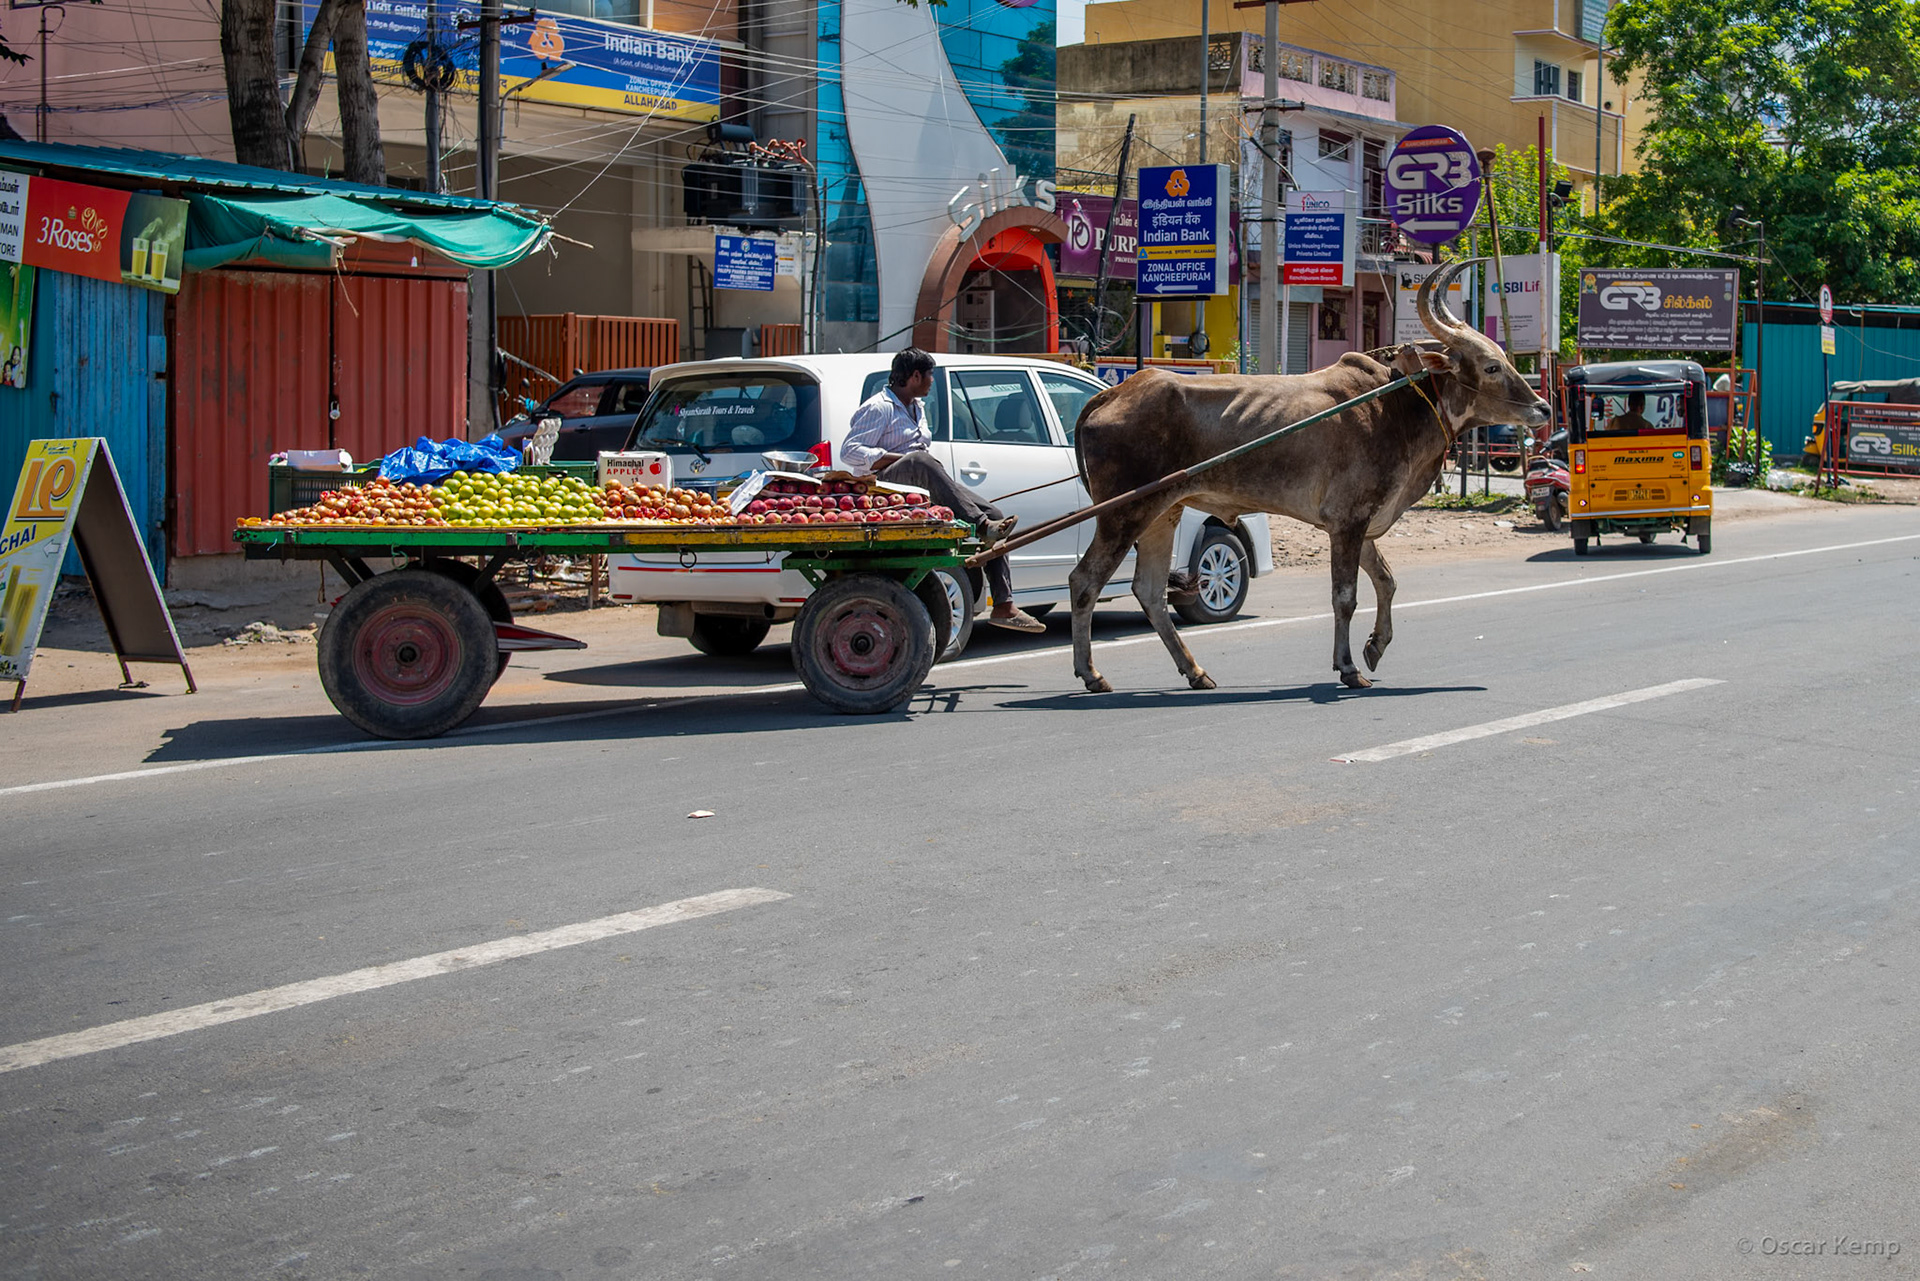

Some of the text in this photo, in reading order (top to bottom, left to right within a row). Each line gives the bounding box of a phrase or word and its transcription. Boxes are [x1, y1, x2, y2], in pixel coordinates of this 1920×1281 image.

[604, 31, 695, 65] Indian Bank
[634, 60, 640, 68] of
[640, 61, 654, 70] India
[625, 83, 676, 97] KANCHEEPURAM
[624, 94, 677, 110] ALLAHABAD
[1387, 151, 1472, 190] GRB
[1142, 197, 1212, 210] இந்தியன் வங்கி
[1306, 201, 1330, 209] UNICO
[1396, 193, 1463, 214] Silks
[1152, 212, 1183, 228] इंडियन
[1143, 228, 1210, 242] Indian Bank
[1147, 262, 1206, 272] ZONAL OFFICE
[1142, 271, 1211, 283] KANCHEEPURAM
[1504, 282, 1523, 293] SBI
[1600, 286, 1661, 310] GRB
[727, 405, 734, 414] &
[734, 405, 755, 414] Travels
[1850, 435, 1891, 454] GRB
[607, 459, 644, 468] Himachal
